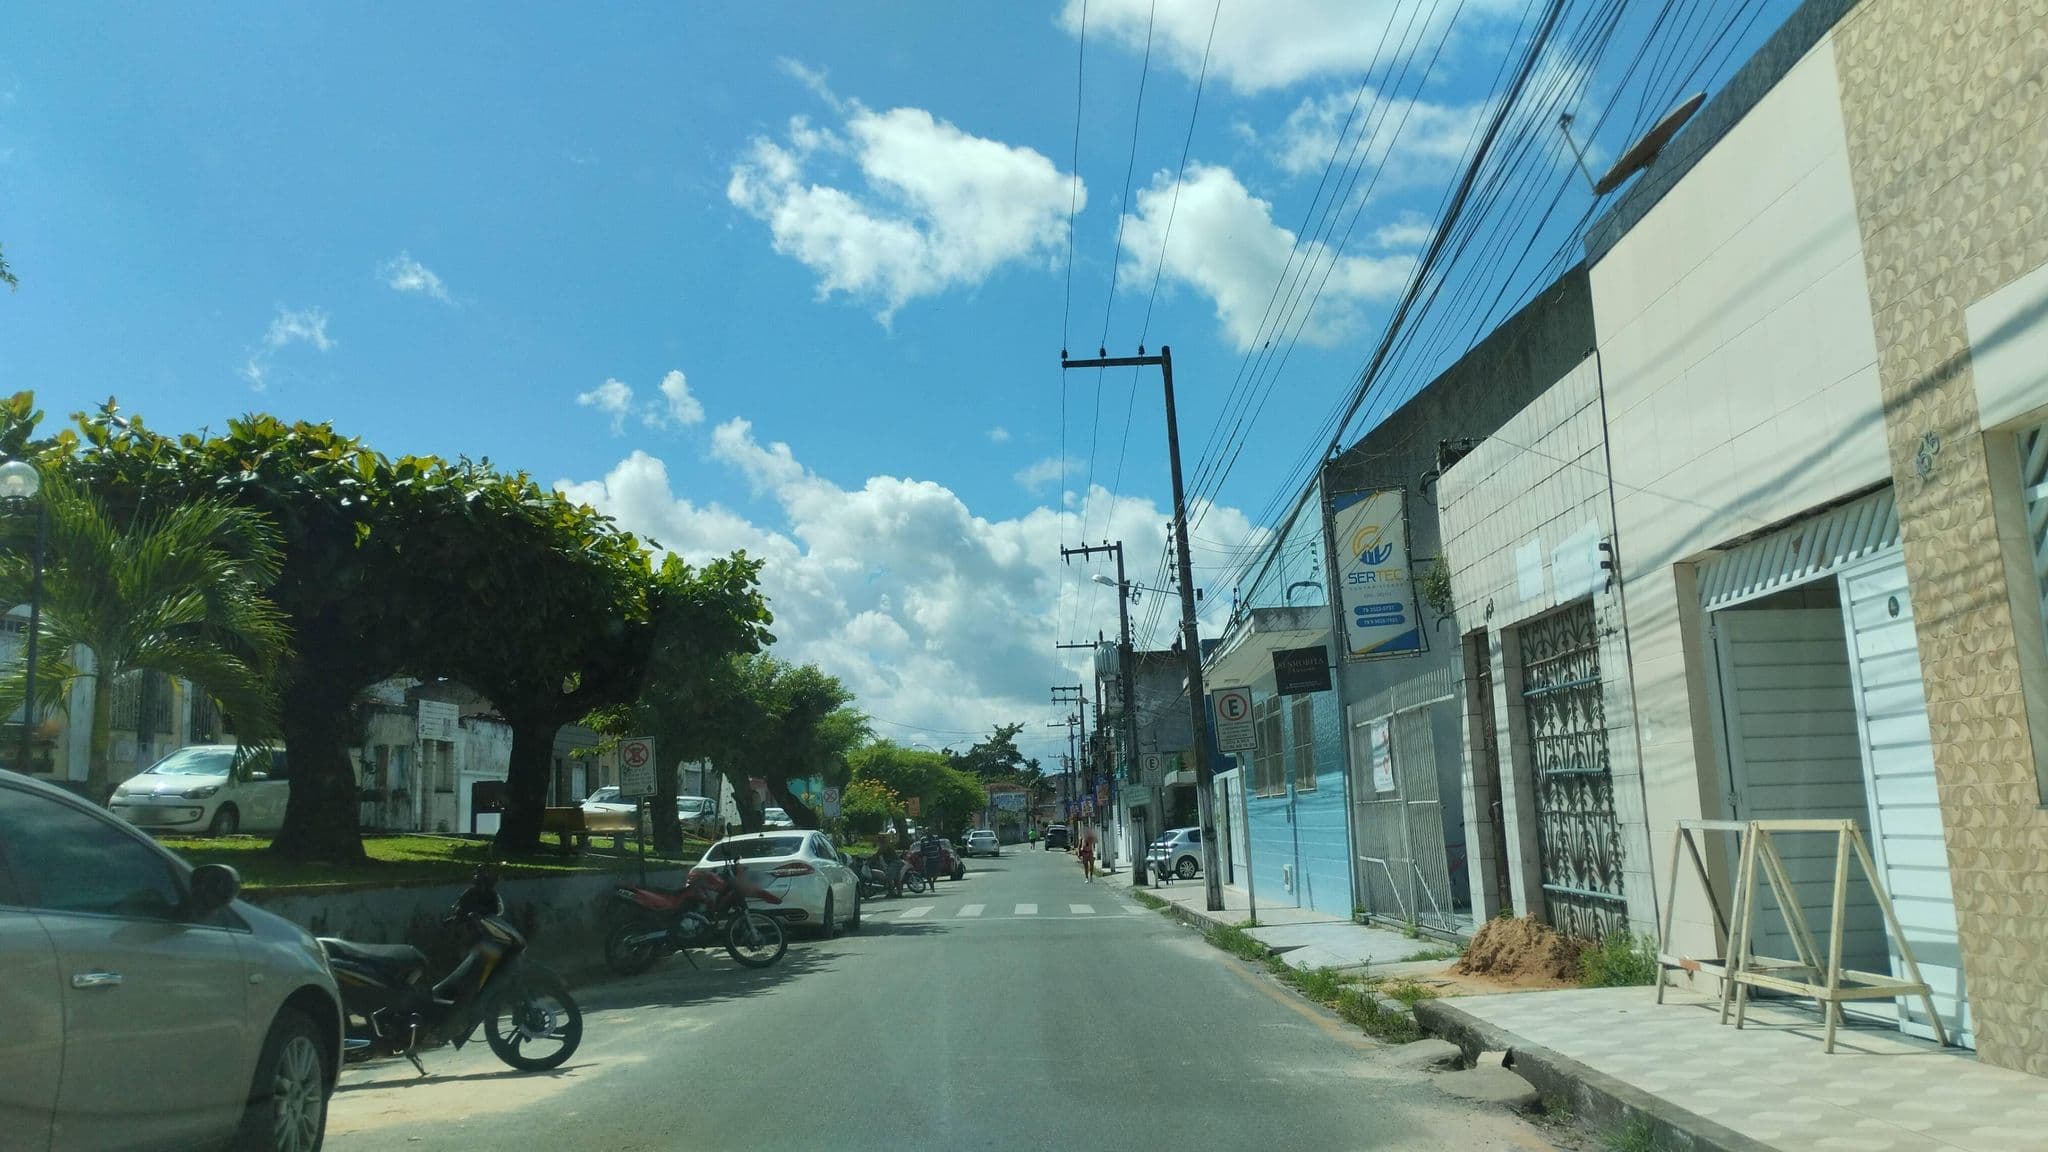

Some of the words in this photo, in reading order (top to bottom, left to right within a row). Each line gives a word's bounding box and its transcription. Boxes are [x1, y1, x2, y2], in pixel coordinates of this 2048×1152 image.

[1348, 568, 1403, 585] SERTEC
[1228, 699, 1240, 717] E
[1149, 758, 1156, 769] E
